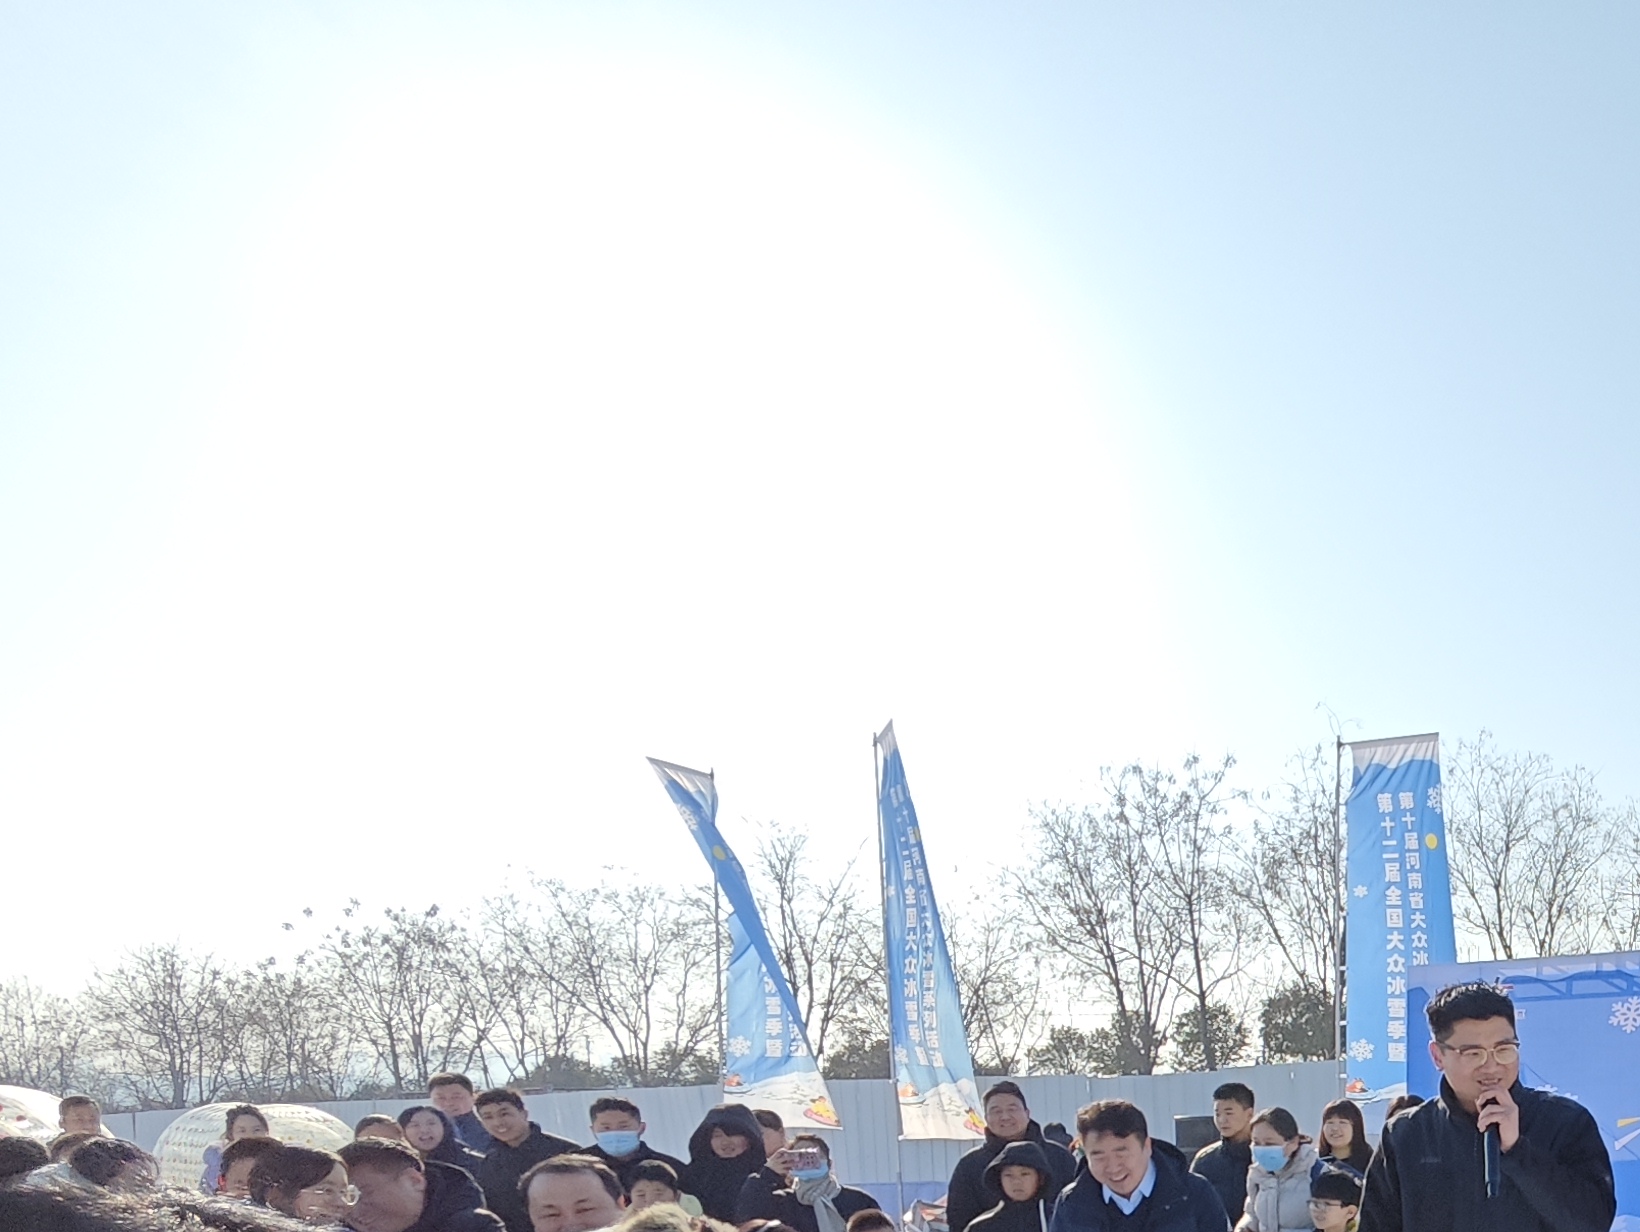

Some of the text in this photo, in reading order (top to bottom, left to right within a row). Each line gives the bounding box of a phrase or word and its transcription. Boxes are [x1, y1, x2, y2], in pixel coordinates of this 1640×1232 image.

[1376, 792, 1407, 1062] 第十二届全国大众冰雪季暨
[1398, 791, 1430, 966] 第十届河南省大众冰
